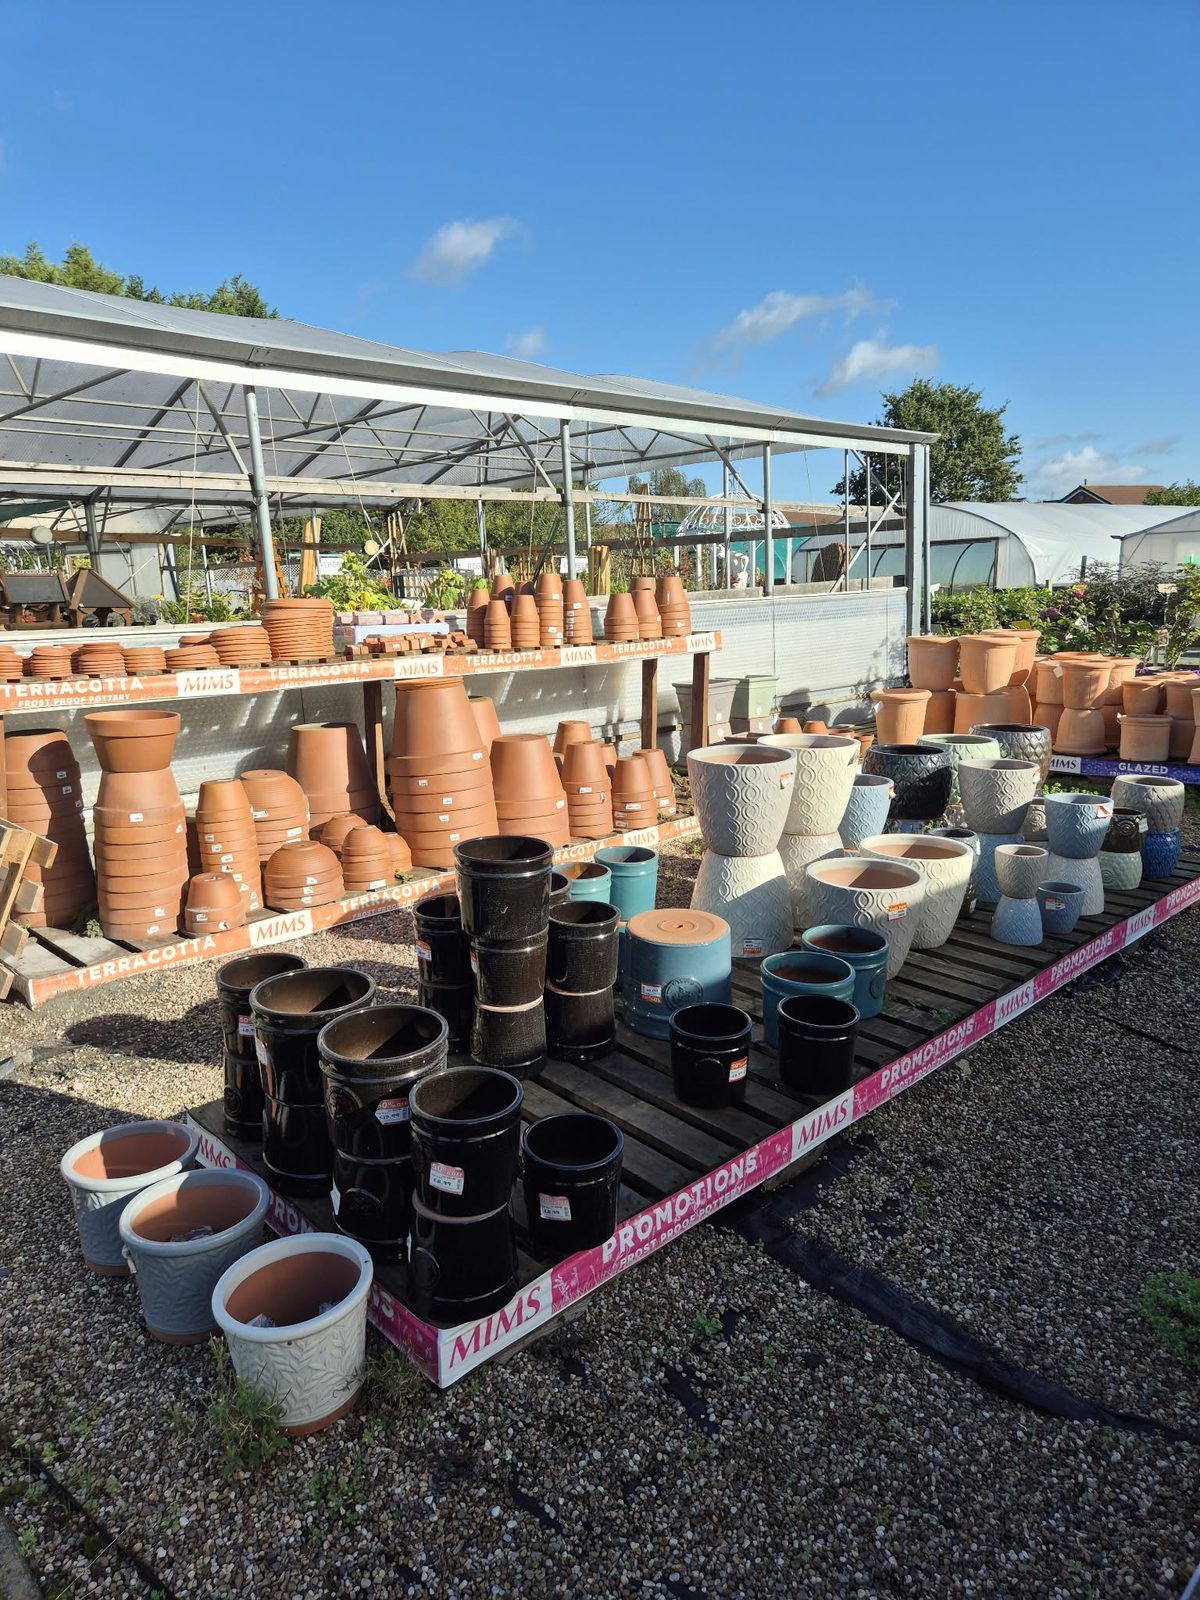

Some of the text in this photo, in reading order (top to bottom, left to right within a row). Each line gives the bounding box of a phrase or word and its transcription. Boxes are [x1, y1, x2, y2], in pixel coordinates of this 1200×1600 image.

[612, 640, 672, 655] TERRACOTTA
[689, 636, 713, 648] MIMS
[465, 651, 543, 667] TERRACOTTA
[564, 649, 593, 662] MIMS
[268, 663, 370, 681] TERRACOTTA
[400, 660, 438, 676] MIMS
[1, 677, 144, 698] TERRACOTTA
[184, 674, 234, 692] MIMS
[18, 693, 130, 708] FROST PROOF POTTERY
[1118, 762, 1169, 775] GLAZED
[628, 829, 656, 846] MIMS
[554, 840, 606, 862] RACOTTA
[340, 879, 440, 913] TERRACOTTA
[256, 916, 306, 942] MIMS
[74, 936, 216, 985] TERRACOTTA
[1051, 931, 1113, 982] PROMOTIONS
[998, 986, 1031, 1022] MIMS
[881, 1018, 975, 1089] PROMOTIONS
[797, 1098, 848, 1150] MIMS
[602, 1150, 758, 1264] PROMOTIONS
[620, 1184, 743, 1268] FROST PROOF POTTERY
[449, 1286, 541, 1369] MIMS
